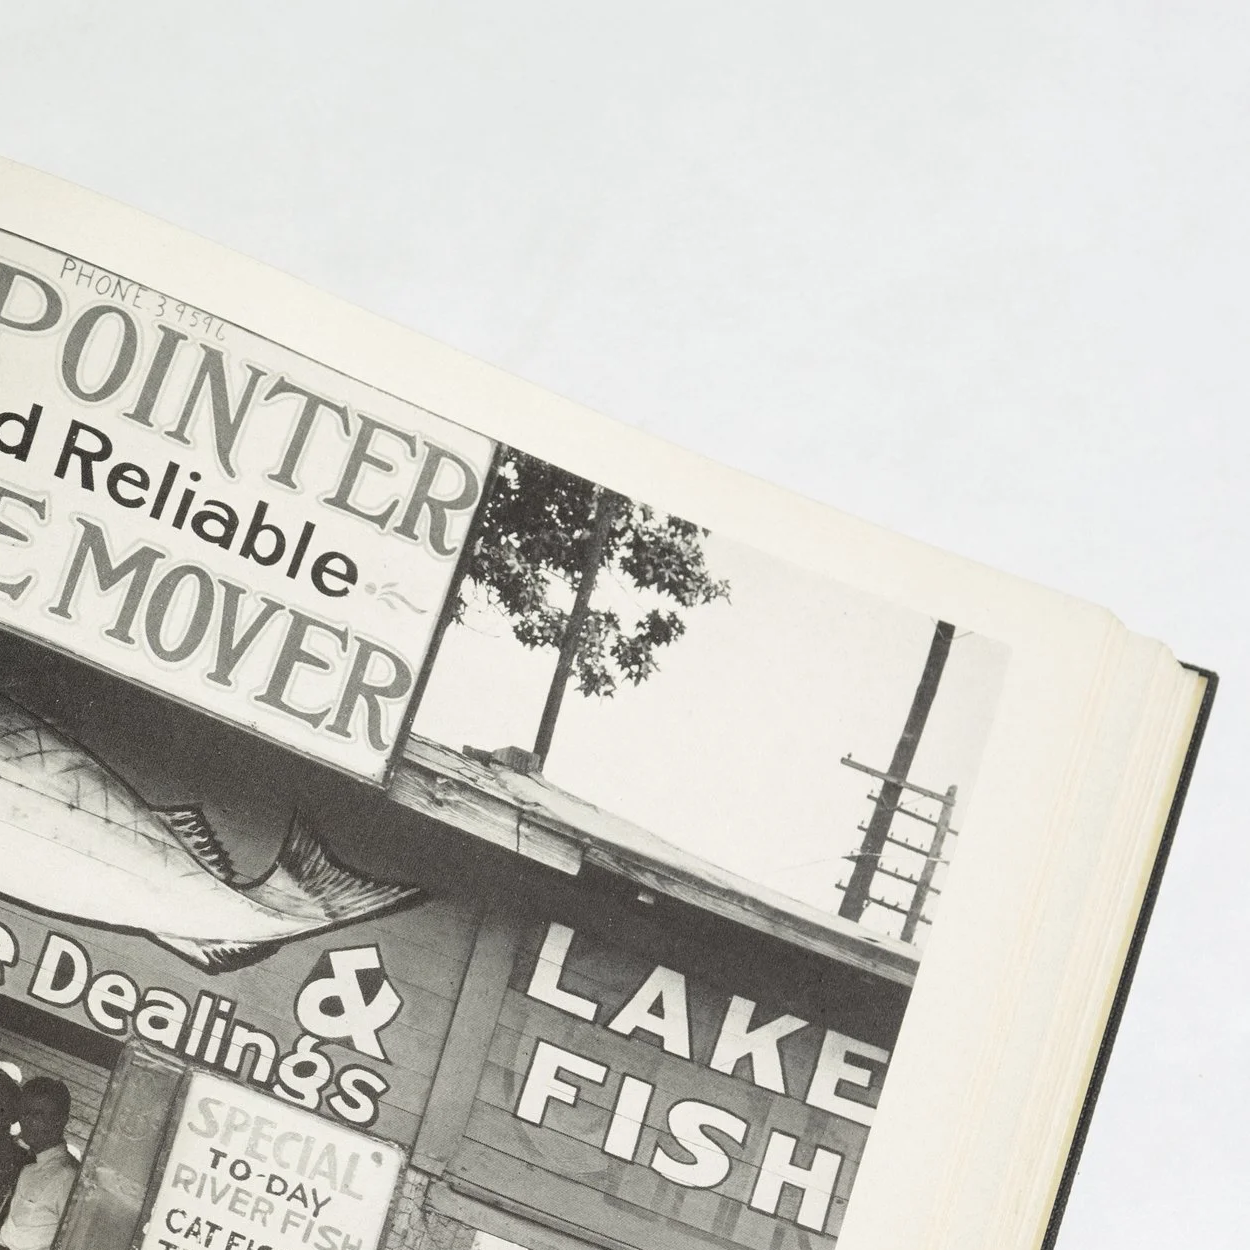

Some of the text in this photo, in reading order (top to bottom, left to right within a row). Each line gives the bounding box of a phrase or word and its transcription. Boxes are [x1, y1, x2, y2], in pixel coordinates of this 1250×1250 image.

[60, 257, 149, 309] PHONE
[54, 420, 360, 599] Reliable
[49, 515, 415, 752] MOVER
[30, 932, 390, 1127] Dealings
[294, 944, 402, 1062] &
[527, 922, 890, 1127] LAKE
[171, 1162, 275, 1227] RIVER
[516, 1039, 844, 1234] FISH
